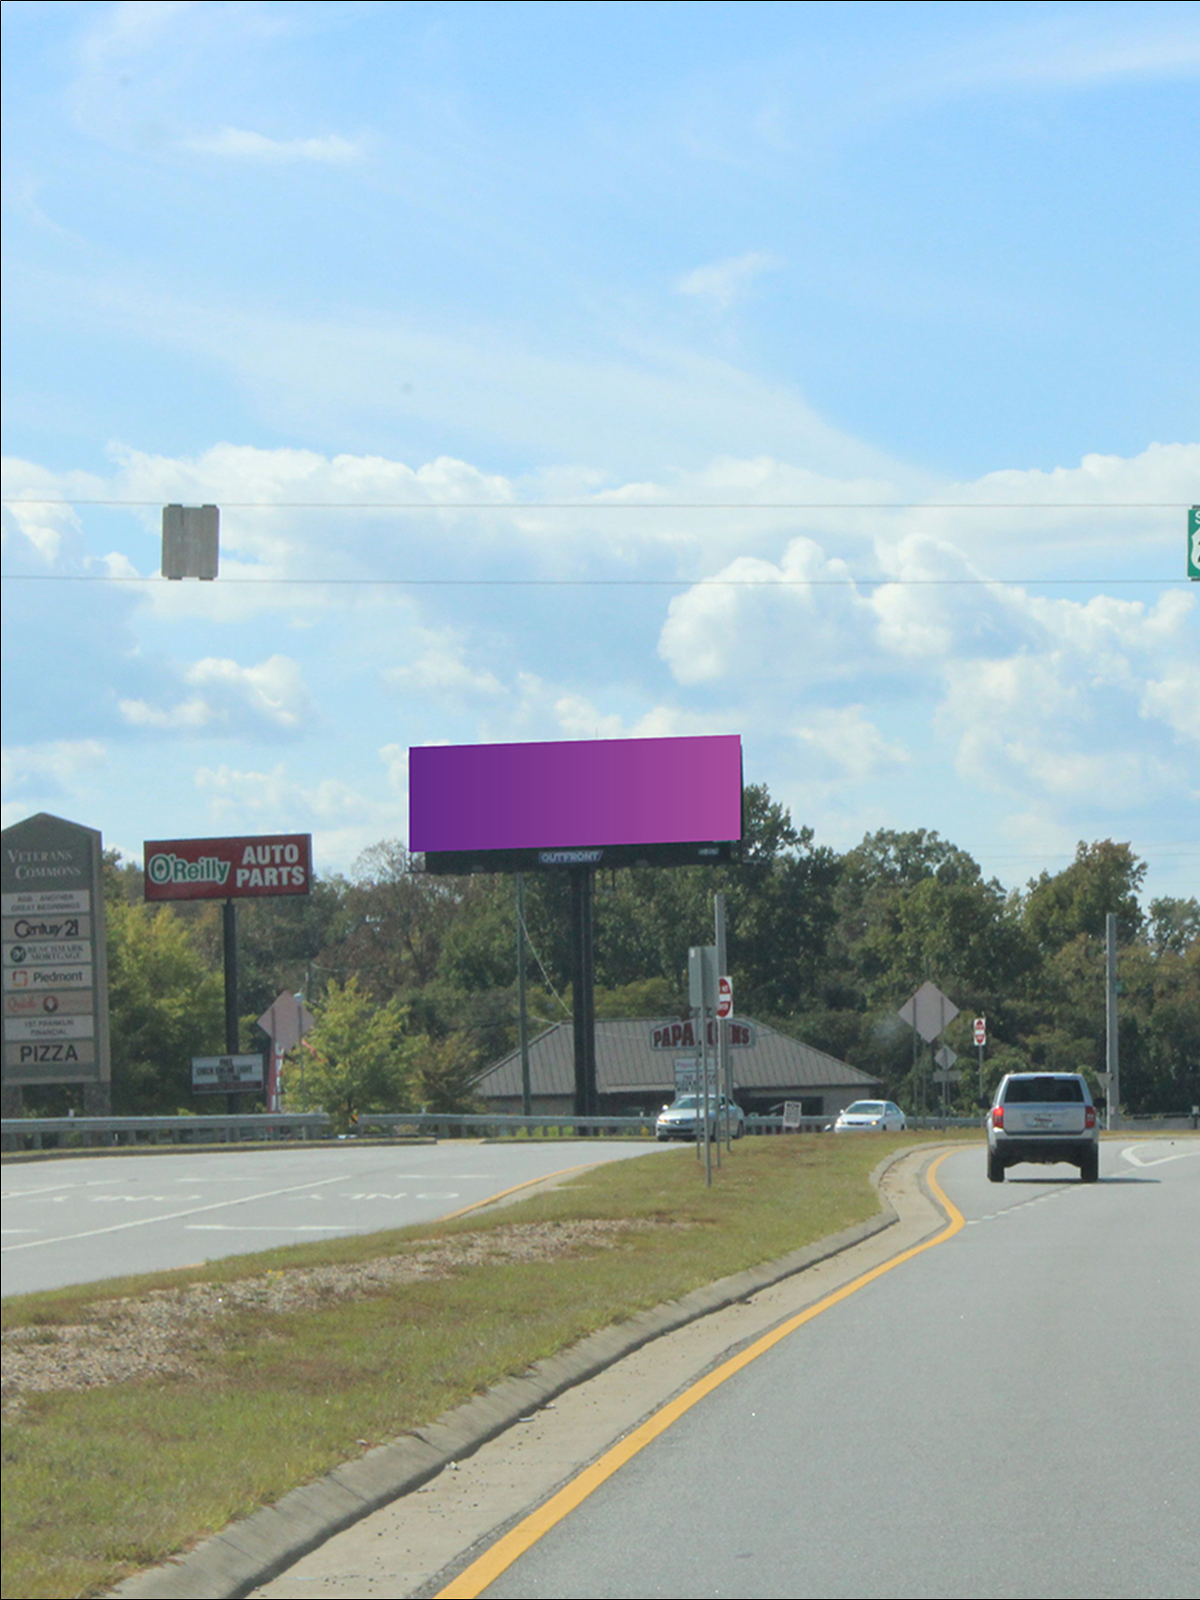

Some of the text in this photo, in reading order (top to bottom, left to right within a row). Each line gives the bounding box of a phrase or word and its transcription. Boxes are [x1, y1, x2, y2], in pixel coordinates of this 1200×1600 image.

[7, 850, 73, 862] VETERANS
[242, 844, 299, 865] AUTO
[541, 852, 600, 863] OUTFRONT
[15, 865, 81, 879] COMMONS
[149, 854, 230, 884] O'Reilly
[236, 866, 305, 888] PARTS
[14, 919, 79, 938] Century 21
[33, 971, 83, 982] Piedmont
[653, 1022, 695, 1047] PAPA
[20, 1045, 78, 1062] PIZZA
